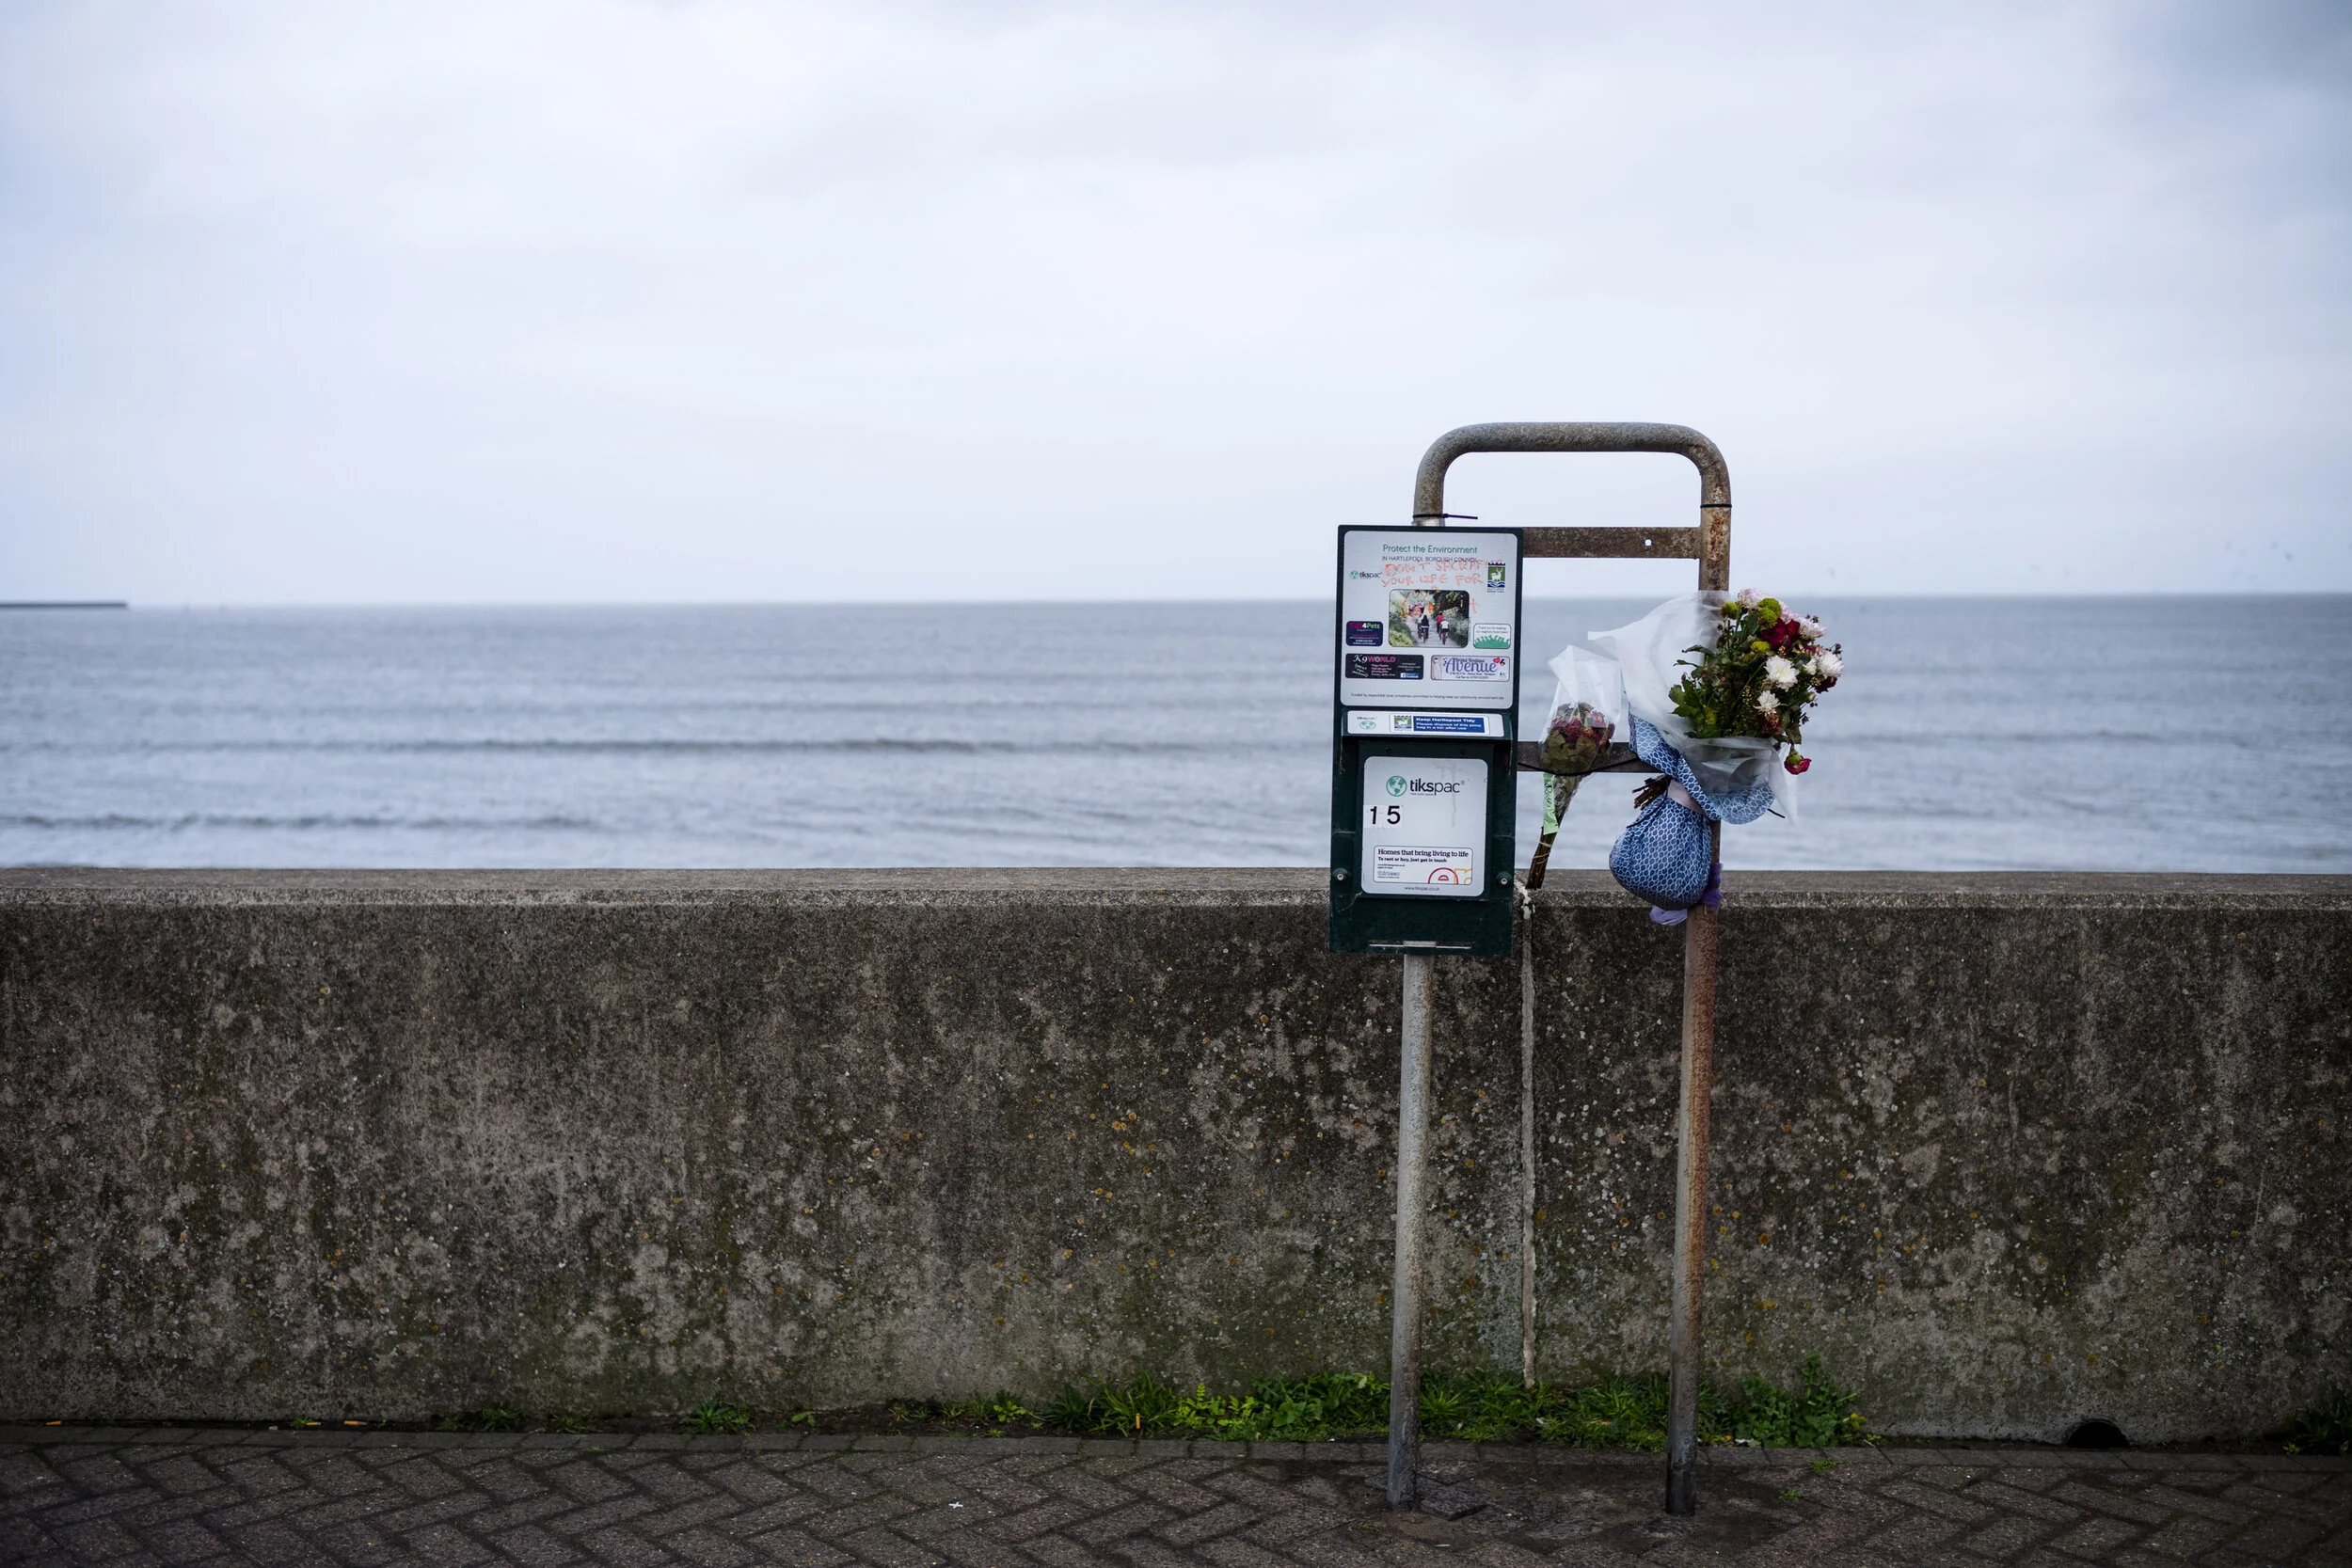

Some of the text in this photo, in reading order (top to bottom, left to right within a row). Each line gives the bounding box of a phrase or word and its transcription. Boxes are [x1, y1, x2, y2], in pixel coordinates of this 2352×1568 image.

[1383, 544, 1478, 554] Protect the Environment
[1455, 573, 1484, 586] FOR
[1446, 657, 1497, 673] Avenue
[1410, 778, 1460, 795] tikspac
